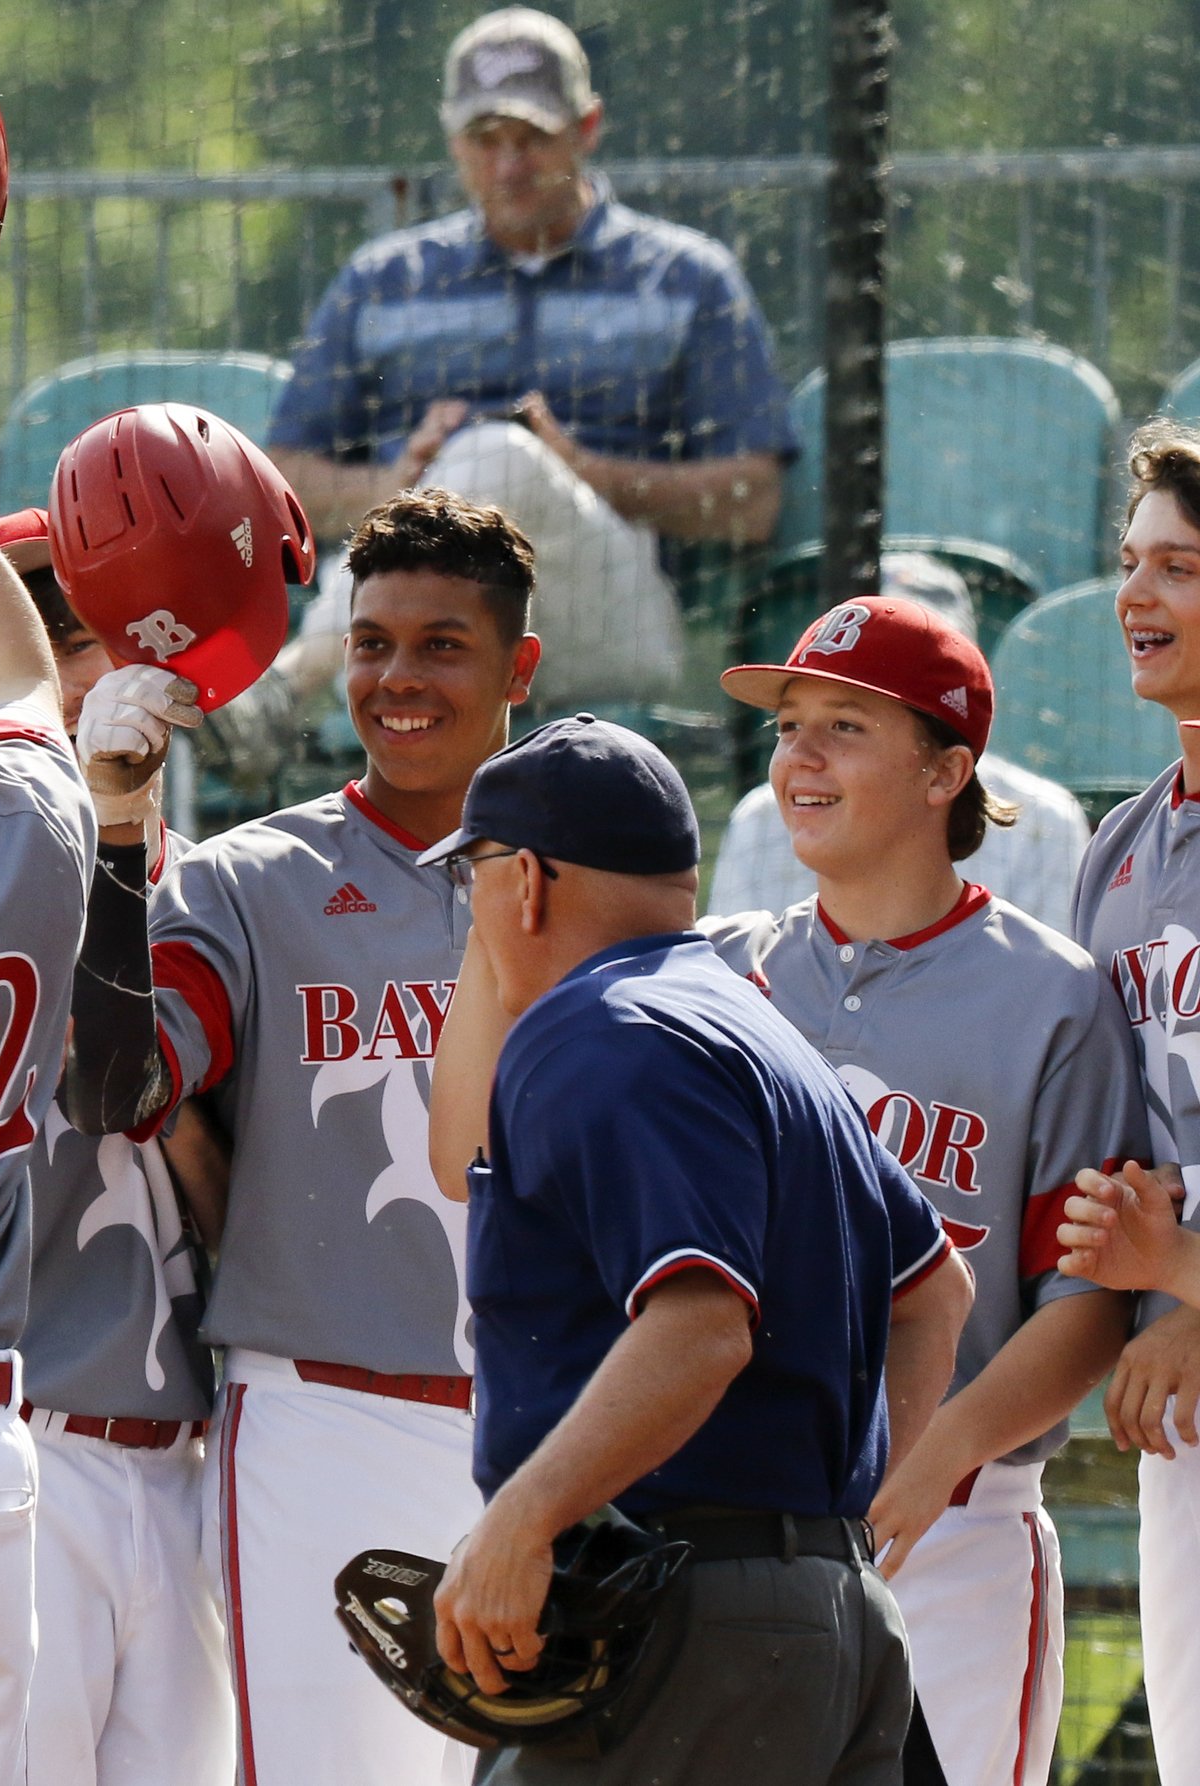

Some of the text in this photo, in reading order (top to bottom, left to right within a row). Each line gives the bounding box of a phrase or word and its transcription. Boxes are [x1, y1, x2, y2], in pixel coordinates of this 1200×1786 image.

[242, 517, 253, 568] adidas
[126, 609, 196, 663] B
[798, 603, 871, 664] B
[323, 898, 377, 917] adidas
